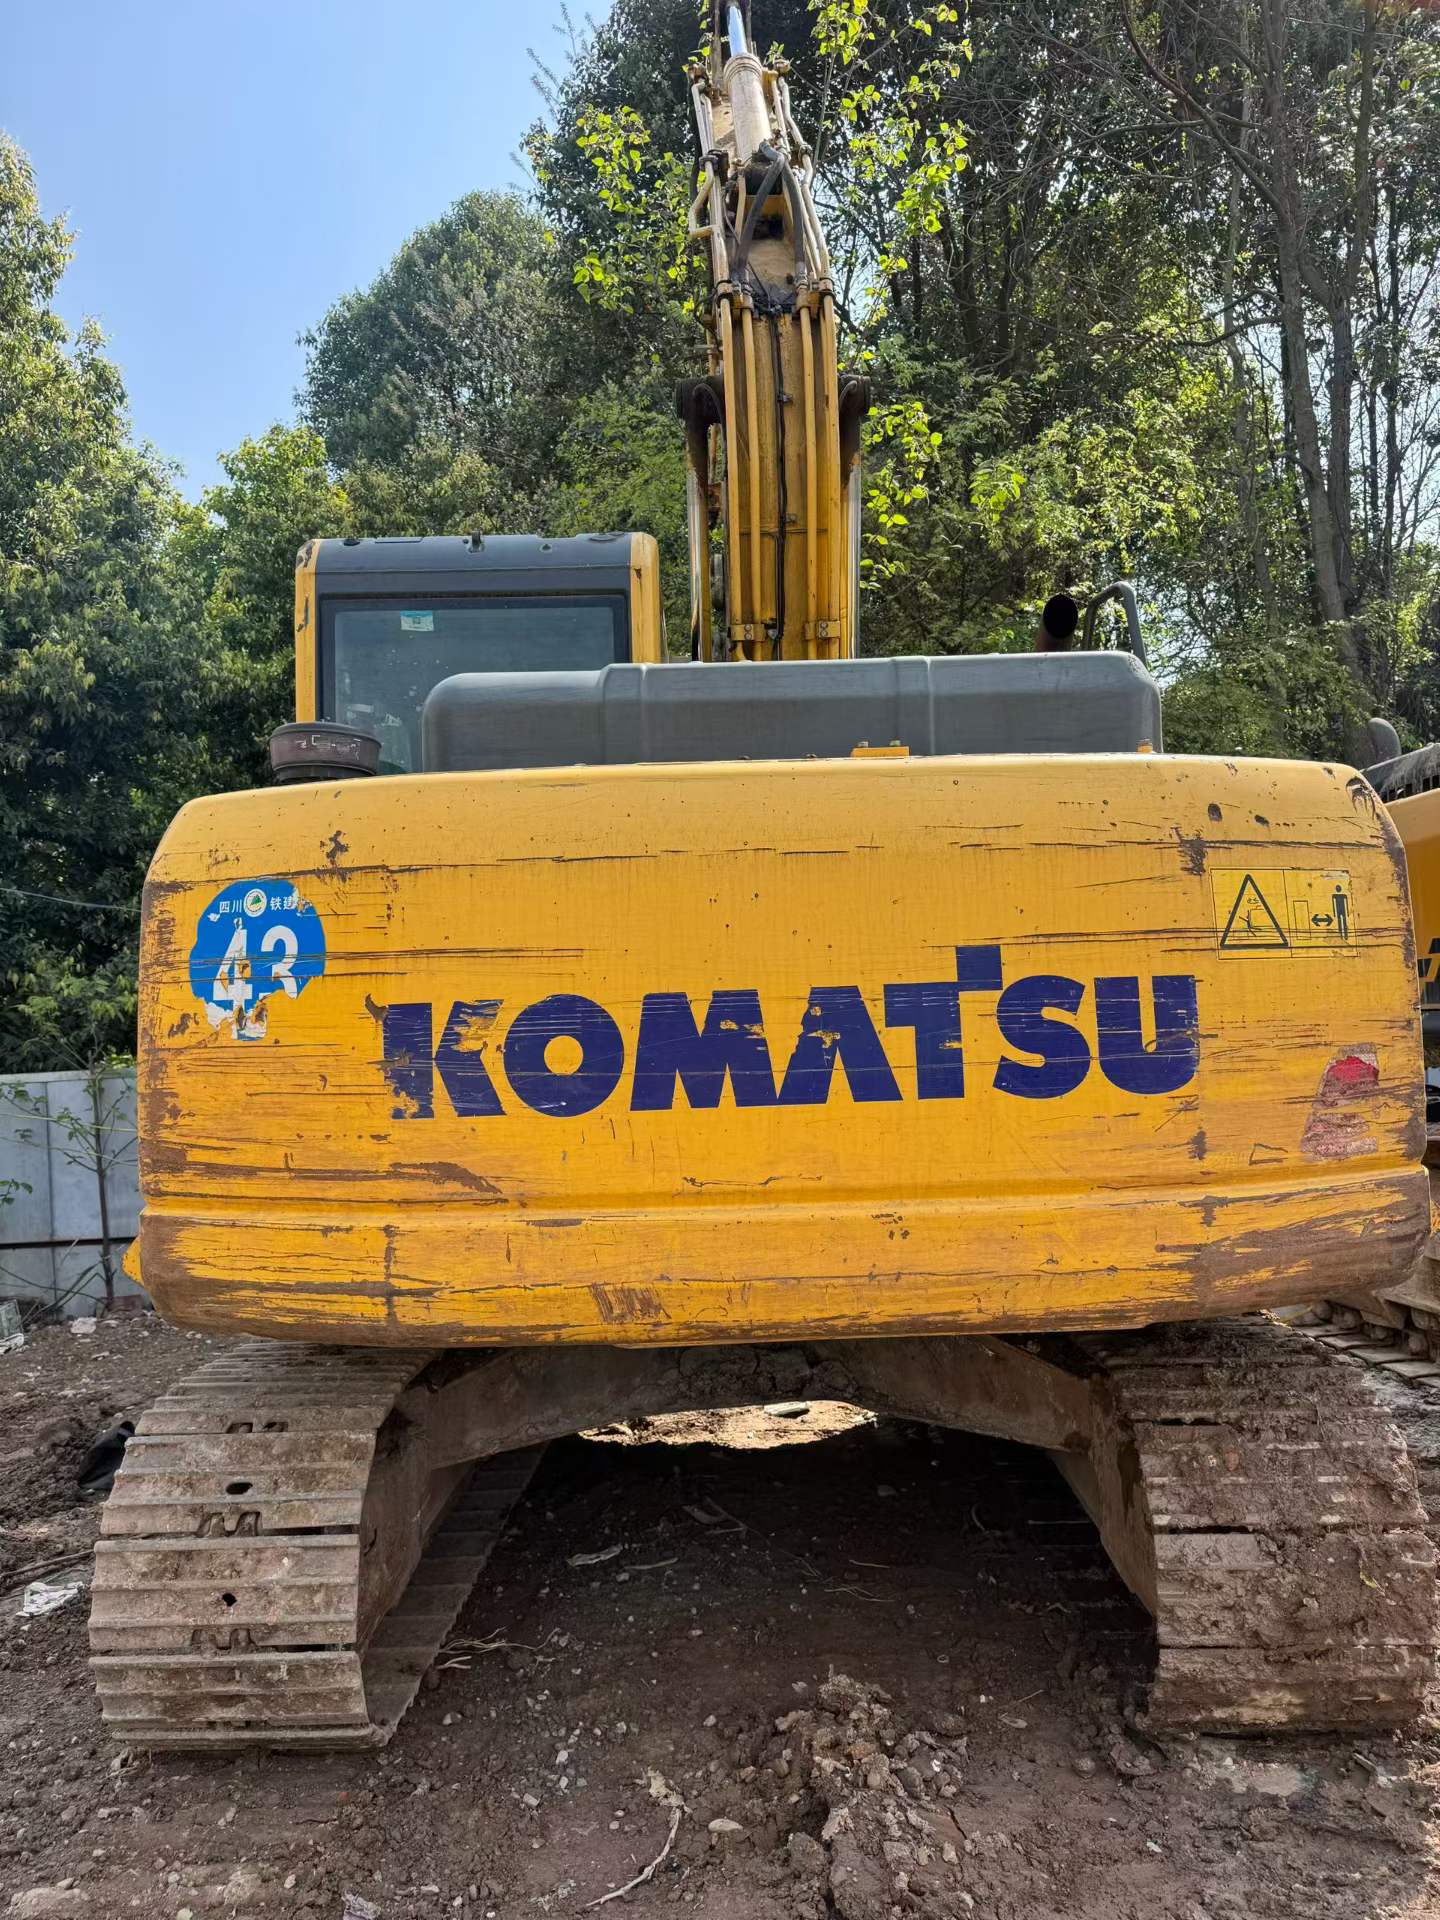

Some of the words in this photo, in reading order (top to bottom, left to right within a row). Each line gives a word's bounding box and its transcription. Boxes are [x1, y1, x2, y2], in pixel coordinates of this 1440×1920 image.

[219, 899, 243, 914] 四川
[212, 924, 299, 1016] 43
[384, 945, 1198, 1119] KOMATSU
